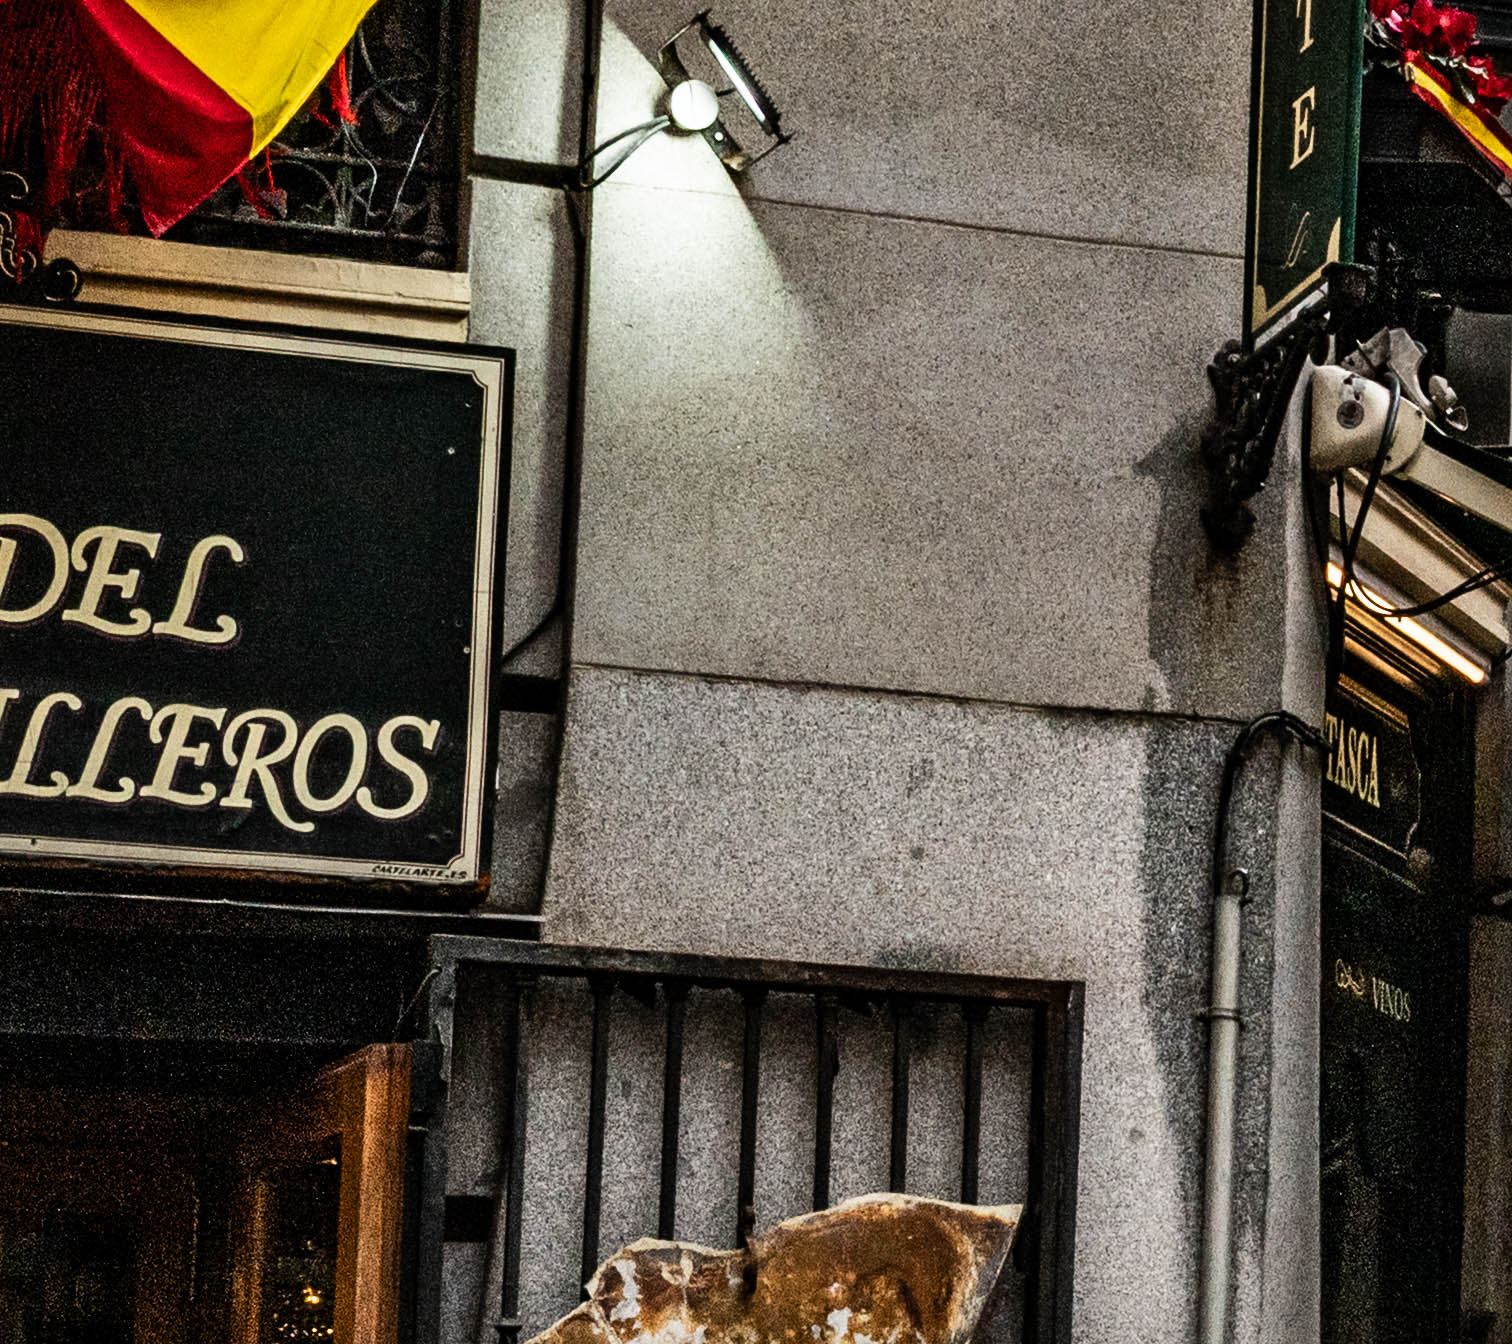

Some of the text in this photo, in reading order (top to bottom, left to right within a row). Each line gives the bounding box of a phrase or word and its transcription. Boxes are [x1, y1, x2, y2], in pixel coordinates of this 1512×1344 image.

[0, 513, 244, 644] DEL
[1325, 711, 1381, 809] TASCA
[1371, 975, 1412, 1023] VINOS
